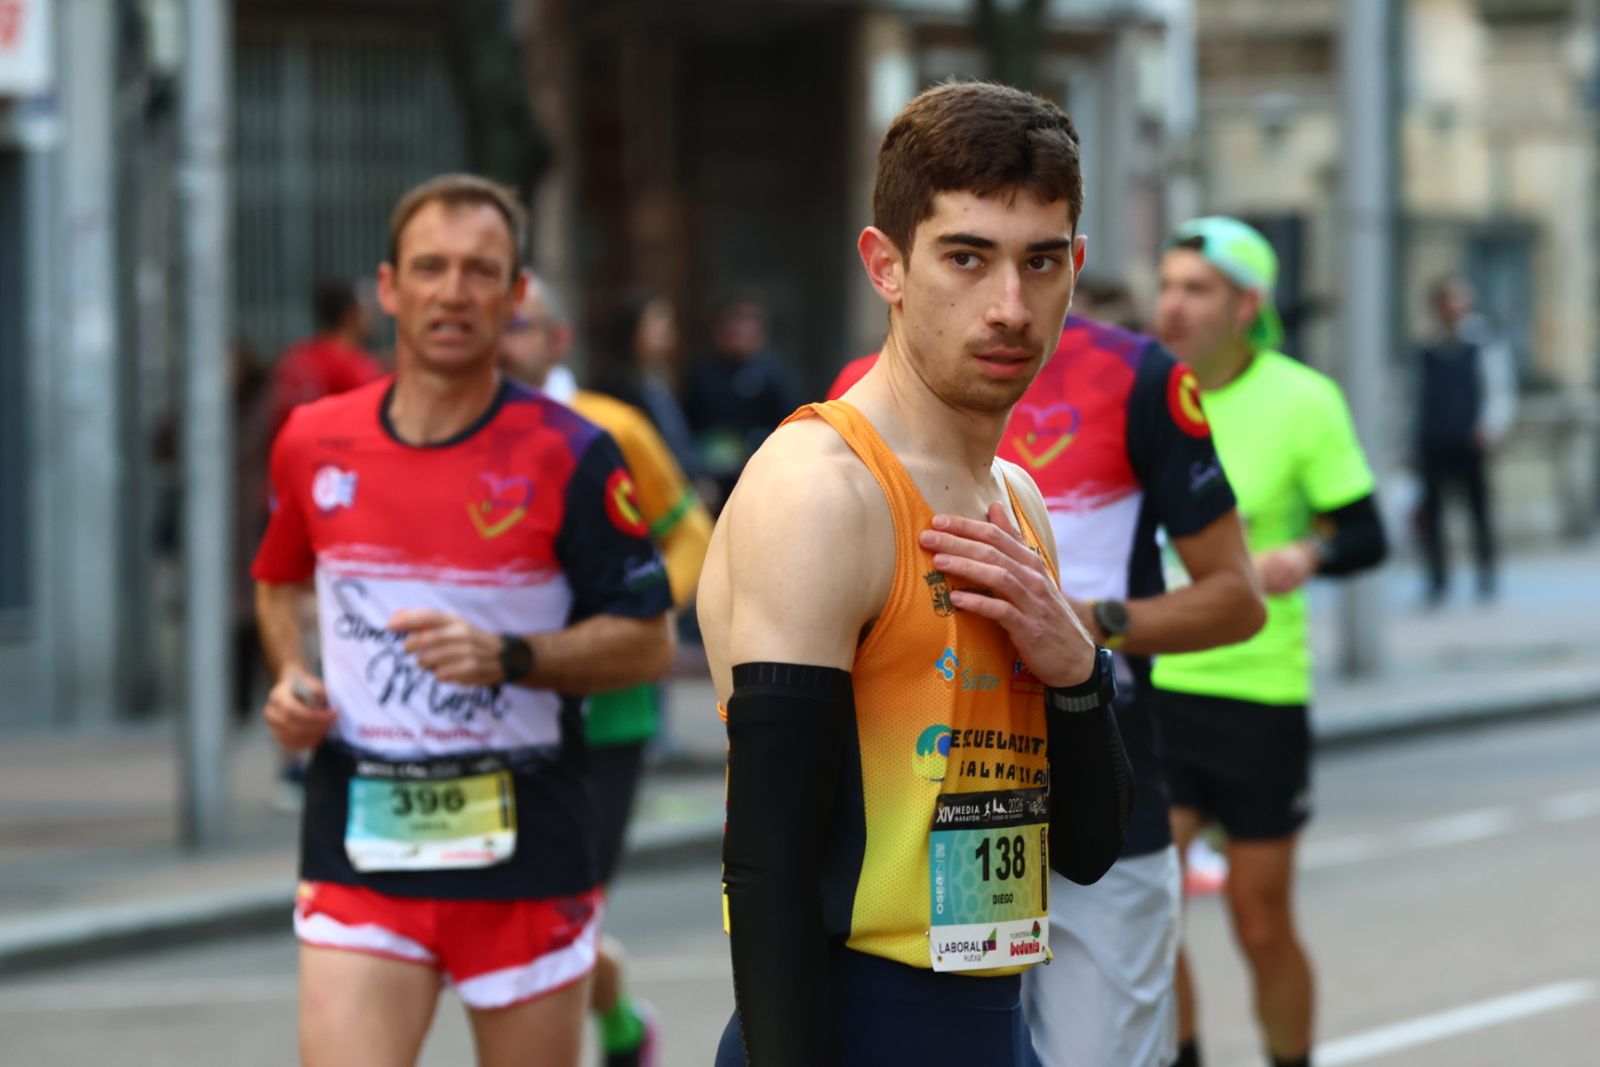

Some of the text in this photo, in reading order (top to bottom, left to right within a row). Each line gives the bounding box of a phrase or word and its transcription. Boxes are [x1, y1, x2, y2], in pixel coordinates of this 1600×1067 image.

[936, 806, 956, 823] XIV
[954, 805, 980, 815] MEDIA
[975, 835, 1026, 882] 138
[992, 893, 1014, 905] DIEGO
[938, 940, 981, 954] LABORAL
[964, 953, 981, 962] kutxa
